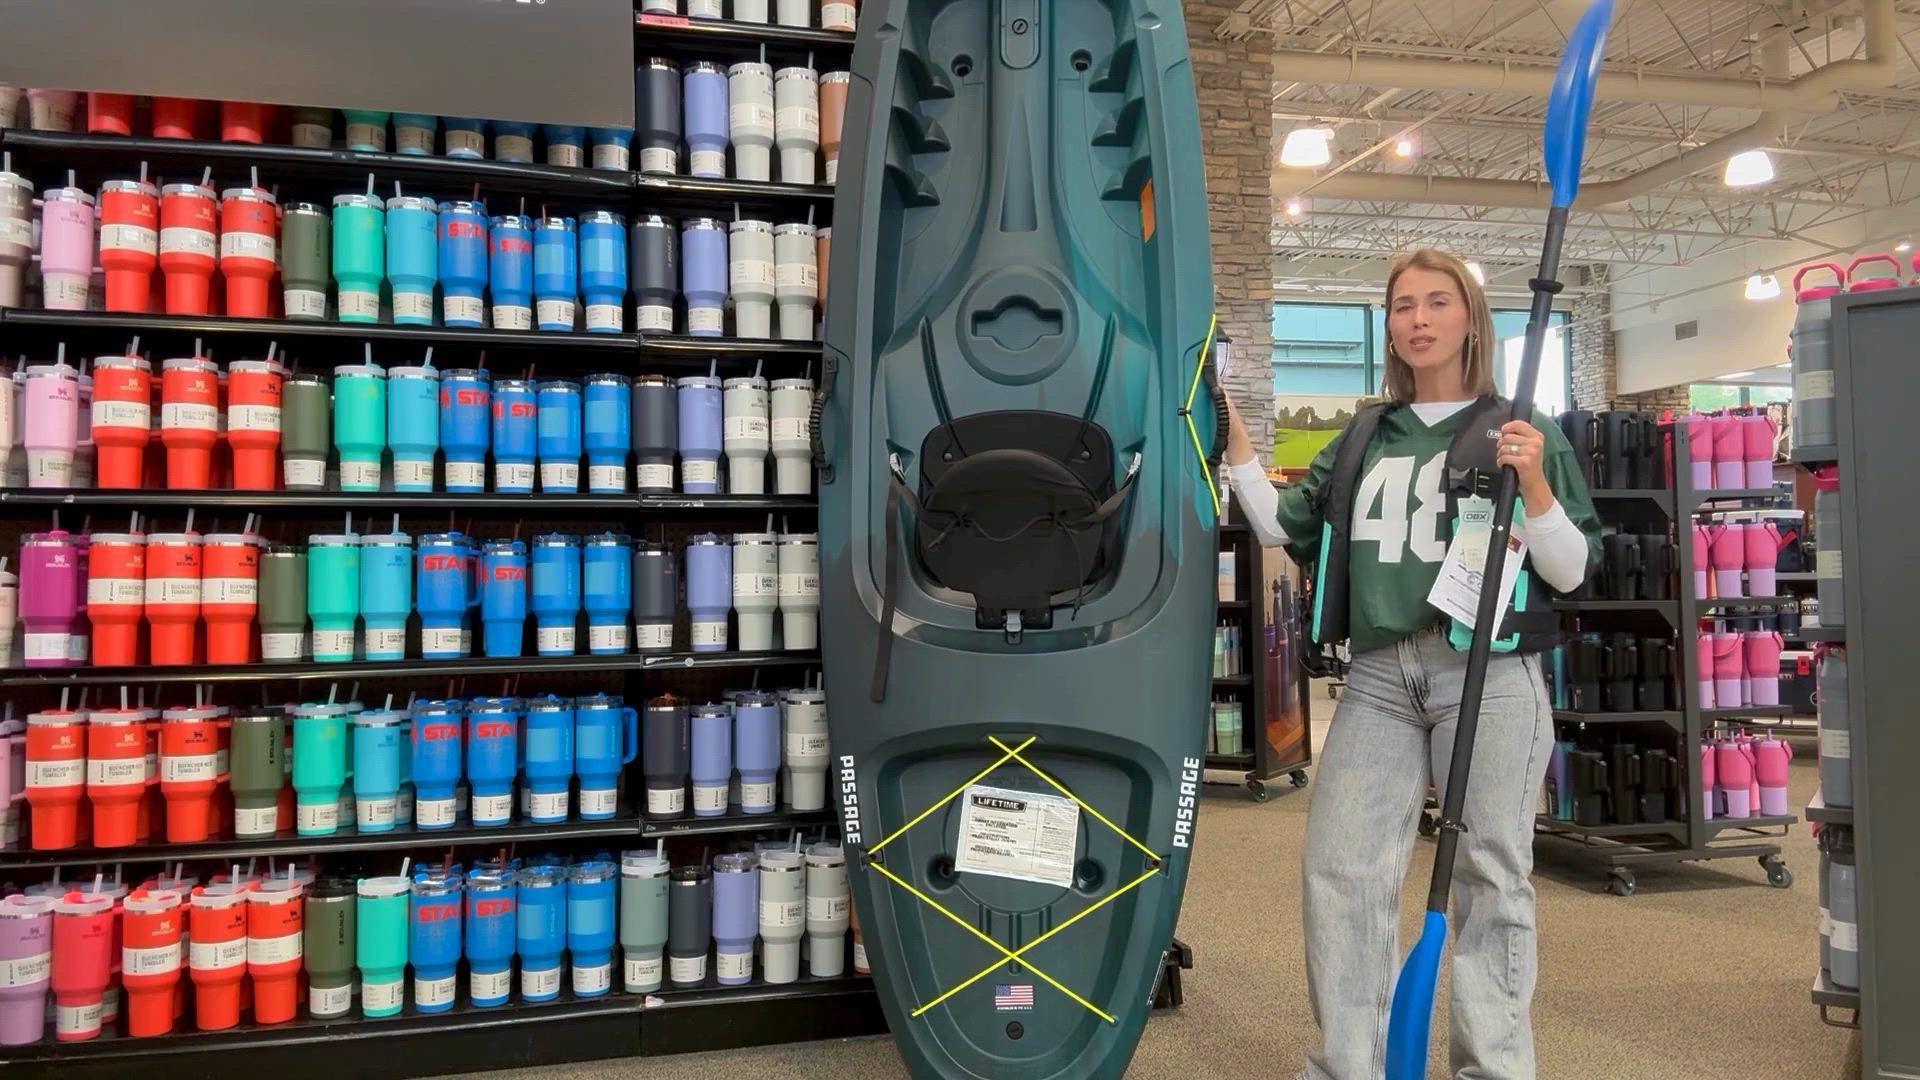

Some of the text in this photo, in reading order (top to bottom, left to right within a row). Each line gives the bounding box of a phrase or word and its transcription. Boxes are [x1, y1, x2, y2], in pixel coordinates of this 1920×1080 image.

[1351, 450, 1447, 563] 48
[839, 755, 861, 844] PASSAGE
[978, 797, 1020, 810] LIFETIME
[1173, 757, 1200, 848] PASSAGE
